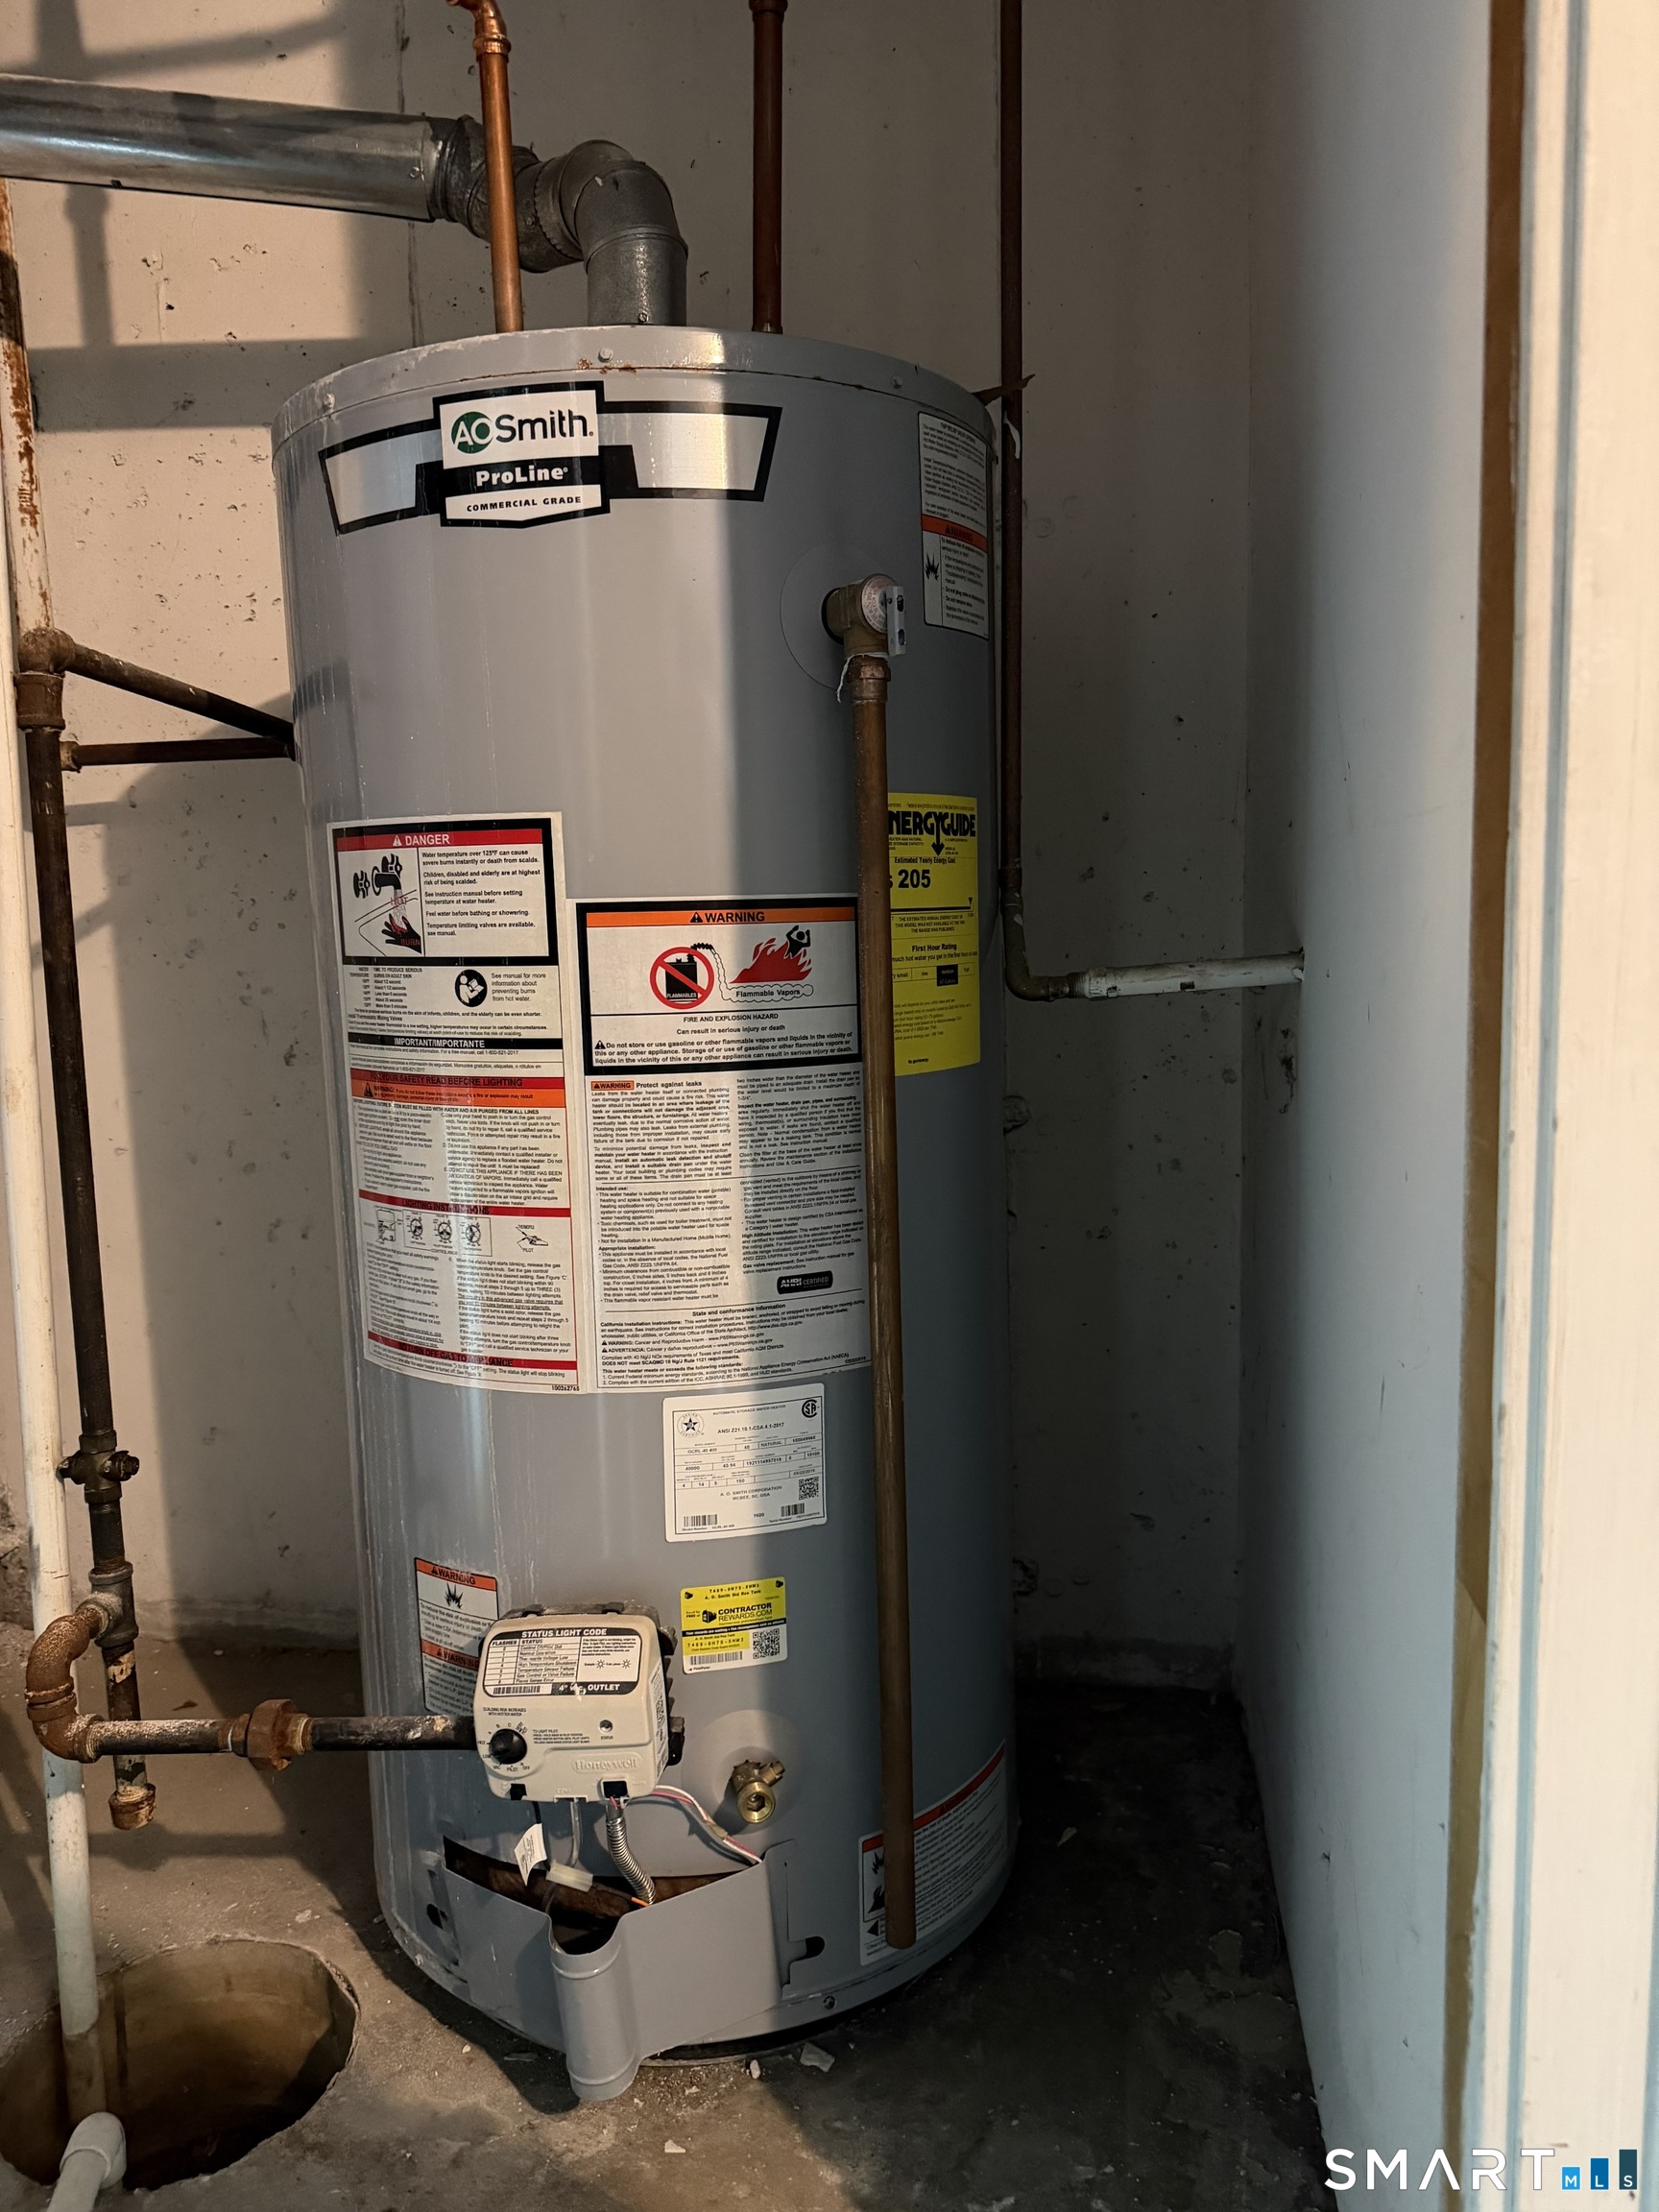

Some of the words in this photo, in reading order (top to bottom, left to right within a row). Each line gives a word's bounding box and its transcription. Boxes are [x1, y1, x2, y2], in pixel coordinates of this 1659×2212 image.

[467, 498, 538, 512] COMMERCIAL
[542, 495, 582, 505] GRADE
[888, 810, 976, 837] NERGYGUIDE
[405, 834, 450, 846] DANGER
[898, 869, 931, 888] 205
[705, 911, 765, 923] WARNING
[482, 1078, 523, 1087] LIGHTING
[438, 1568, 476, 1585] WARNING
[718, 1602, 772, 1615] CONTRACTOR
[718, 1609, 773, 1622] REWARDS.COM
